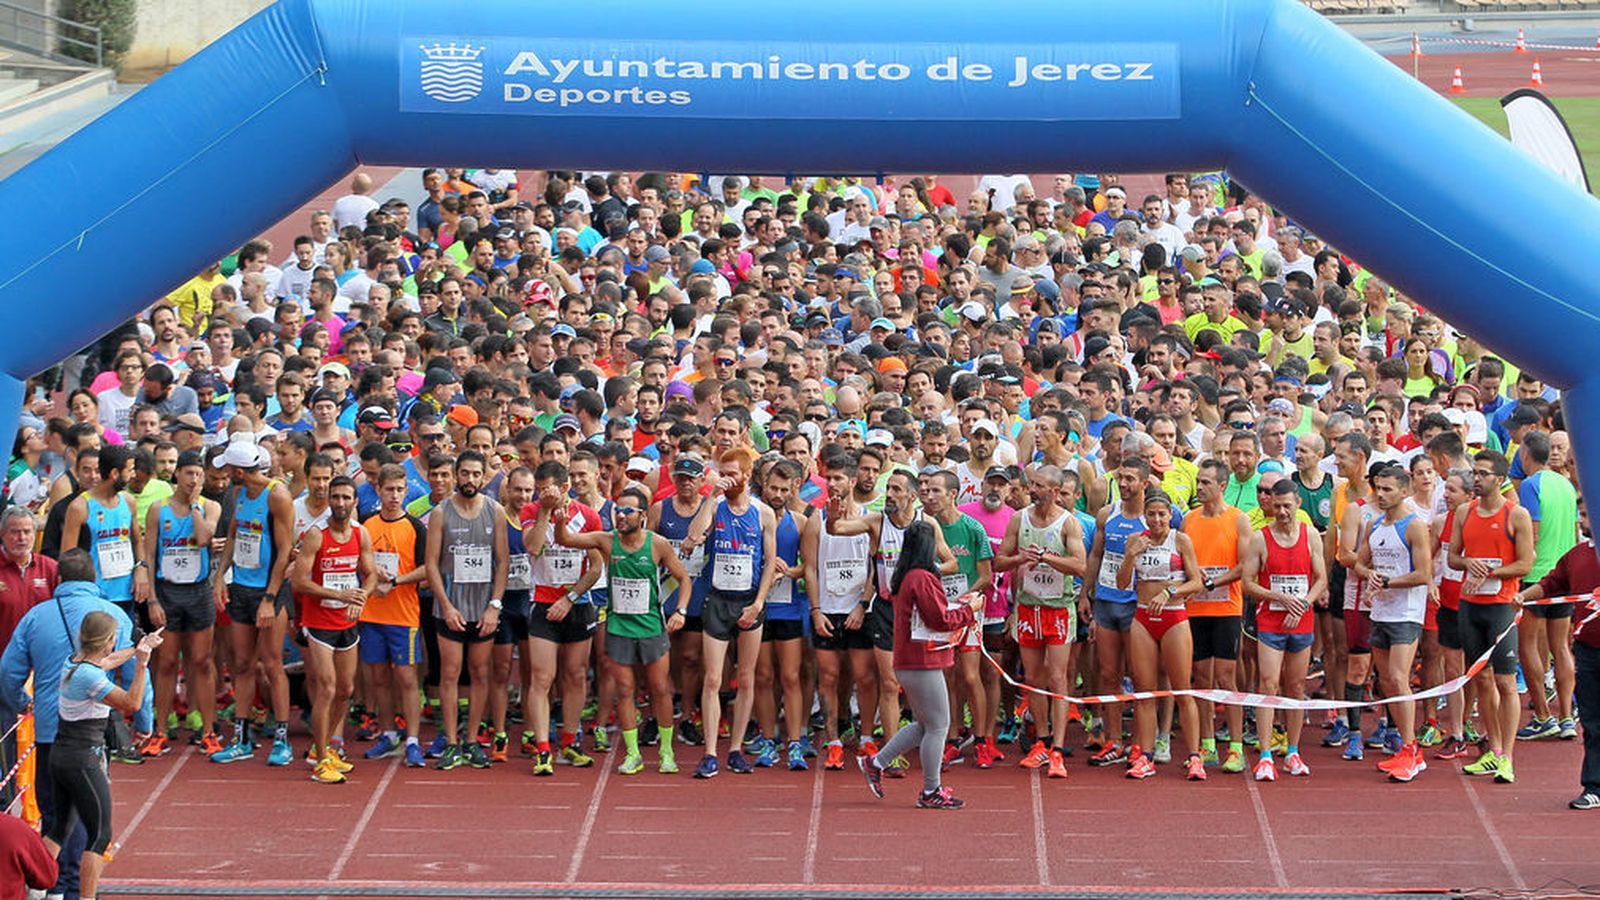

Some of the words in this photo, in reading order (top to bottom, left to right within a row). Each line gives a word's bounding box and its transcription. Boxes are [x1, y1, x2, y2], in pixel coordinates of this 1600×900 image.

[503, 51, 911, 83] Ayuntamiento
[926, 56, 993, 82] de
[1008, 56, 1154, 87] Jerez
[503, 83, 692, 107] Deportes
[174, 558, 188, 568] 95
[464, 557, 483, 568] 584
[554, 559, 572, 569] 124
[1141, 556, 1160, 566] 216
[723, 564, 742, 576] 522
[839, 569, 853, 580] 88
[1034, 573, 1054, 584] 616
[620, 588, 640, 599] 737
